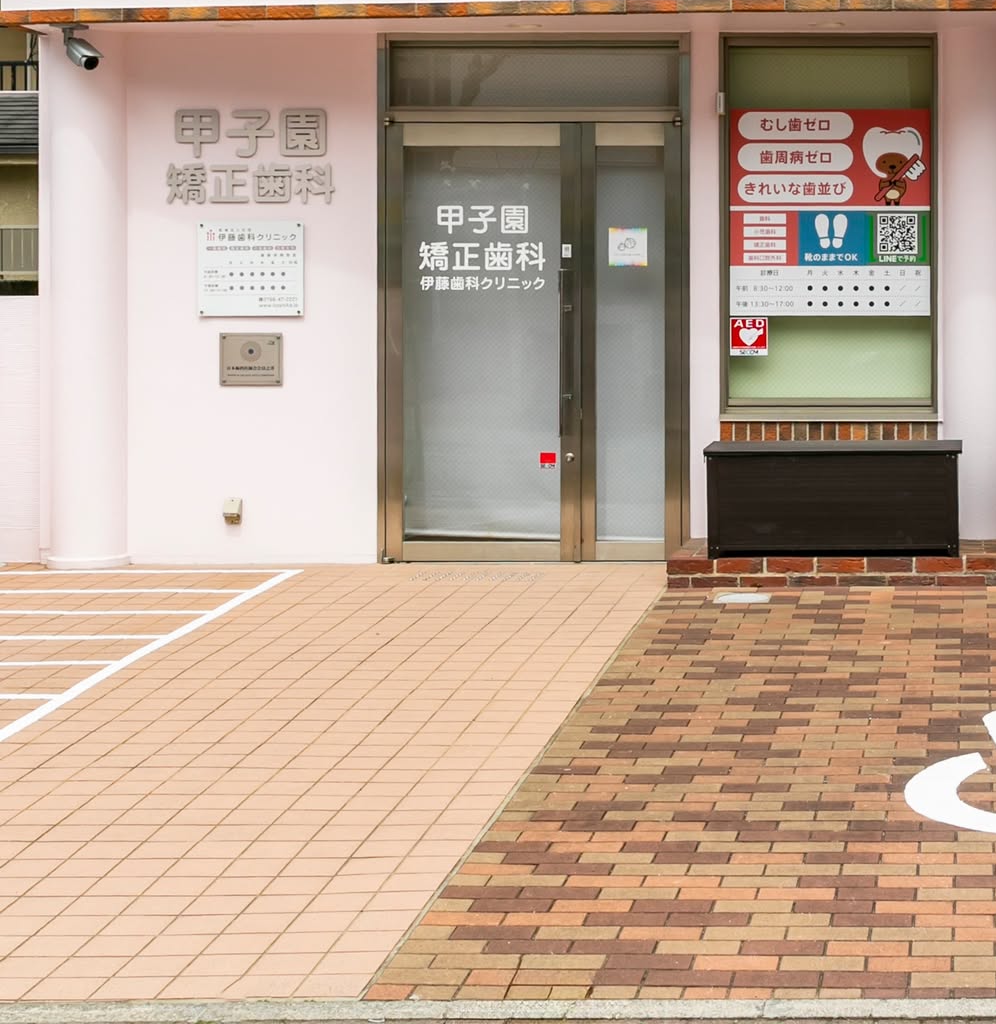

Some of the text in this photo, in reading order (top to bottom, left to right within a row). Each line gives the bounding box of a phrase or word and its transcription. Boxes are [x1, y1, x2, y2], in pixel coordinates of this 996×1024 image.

[760, 117, 831, 132] むし歯ゼロ
[174, 108, 328, 159] 甲子園
[760, 150, 832, 165] 歯周病ゼロ
[166, 162, 336, 205] 矯正歯科
[744, 182, 847, 196] きれいな歯並び
[437, 205, 529, 234] 甲子園
[418, 241, 546, 271] 矯正歯科
[804, 252, 858, 262] 靴のままでOK
[878, 255, 917, 264] LINEで予約
[806, 269, 813, 277] 月
[899, 269, 906, 277] 日
[419, 276, 546, 291] 伊藤歯科クリニック
[733, 319, 765, 328] AED
